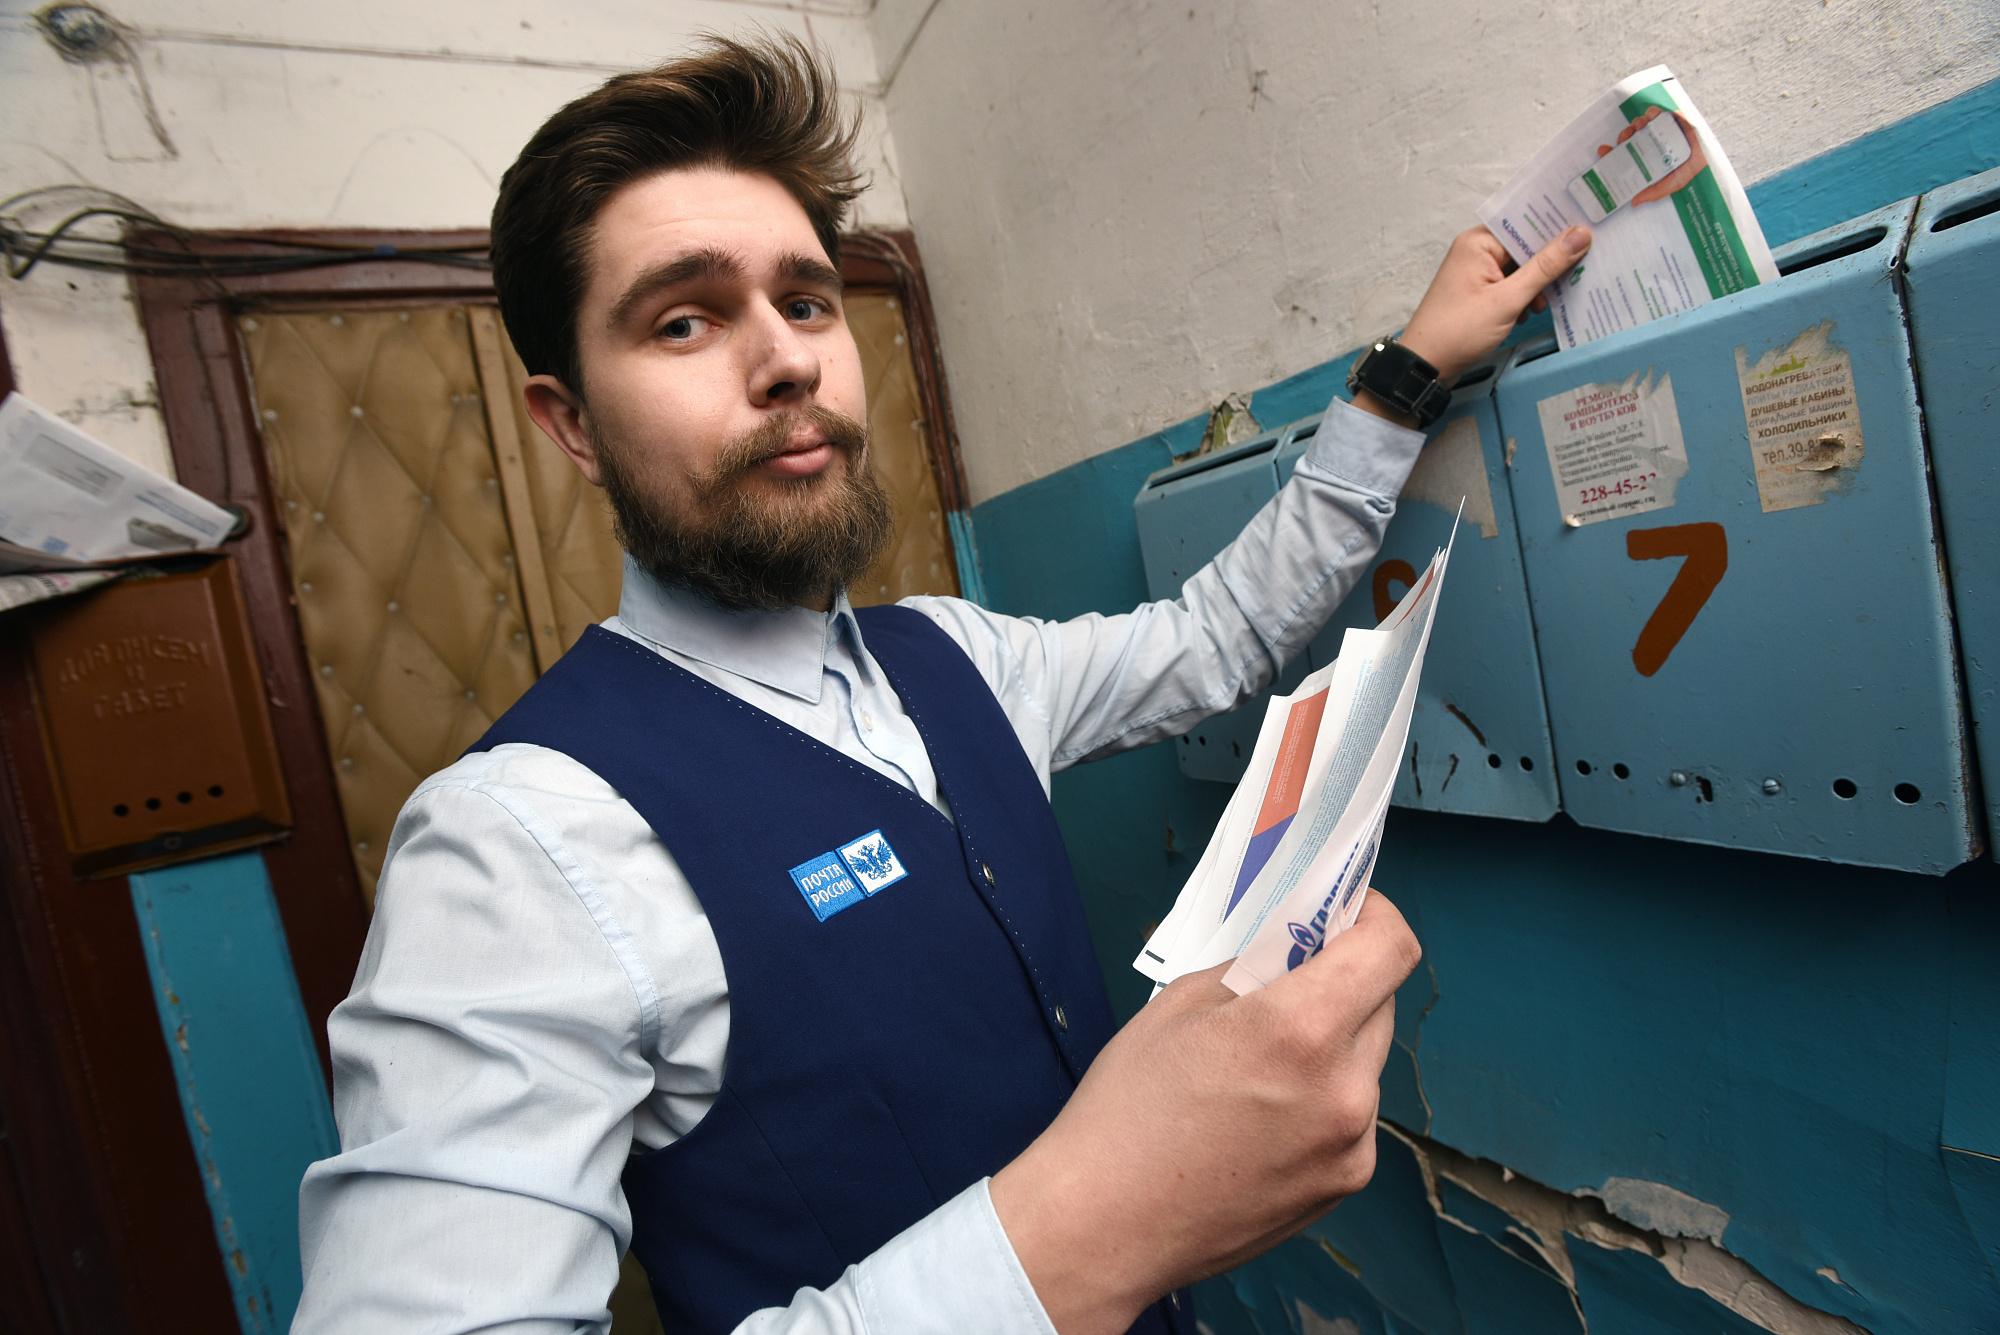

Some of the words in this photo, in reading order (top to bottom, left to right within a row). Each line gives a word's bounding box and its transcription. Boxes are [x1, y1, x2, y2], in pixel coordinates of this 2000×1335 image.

[1751, 398, 1799, 418] ДУШЕВЫЕ
[1801, 386, 1846, 406] КАБИНЫ
[1749, 408, 1807, 428] СТИРАЛЬНЫЕ
[1757, 411, 1847, 439] ХОЛОДИЛЬНИКИ
[1626, 522, 1728, 678] 7
[801, 863, 844, 892] ПОЧТА
[810, 878, 855, 908] РОССИИ
